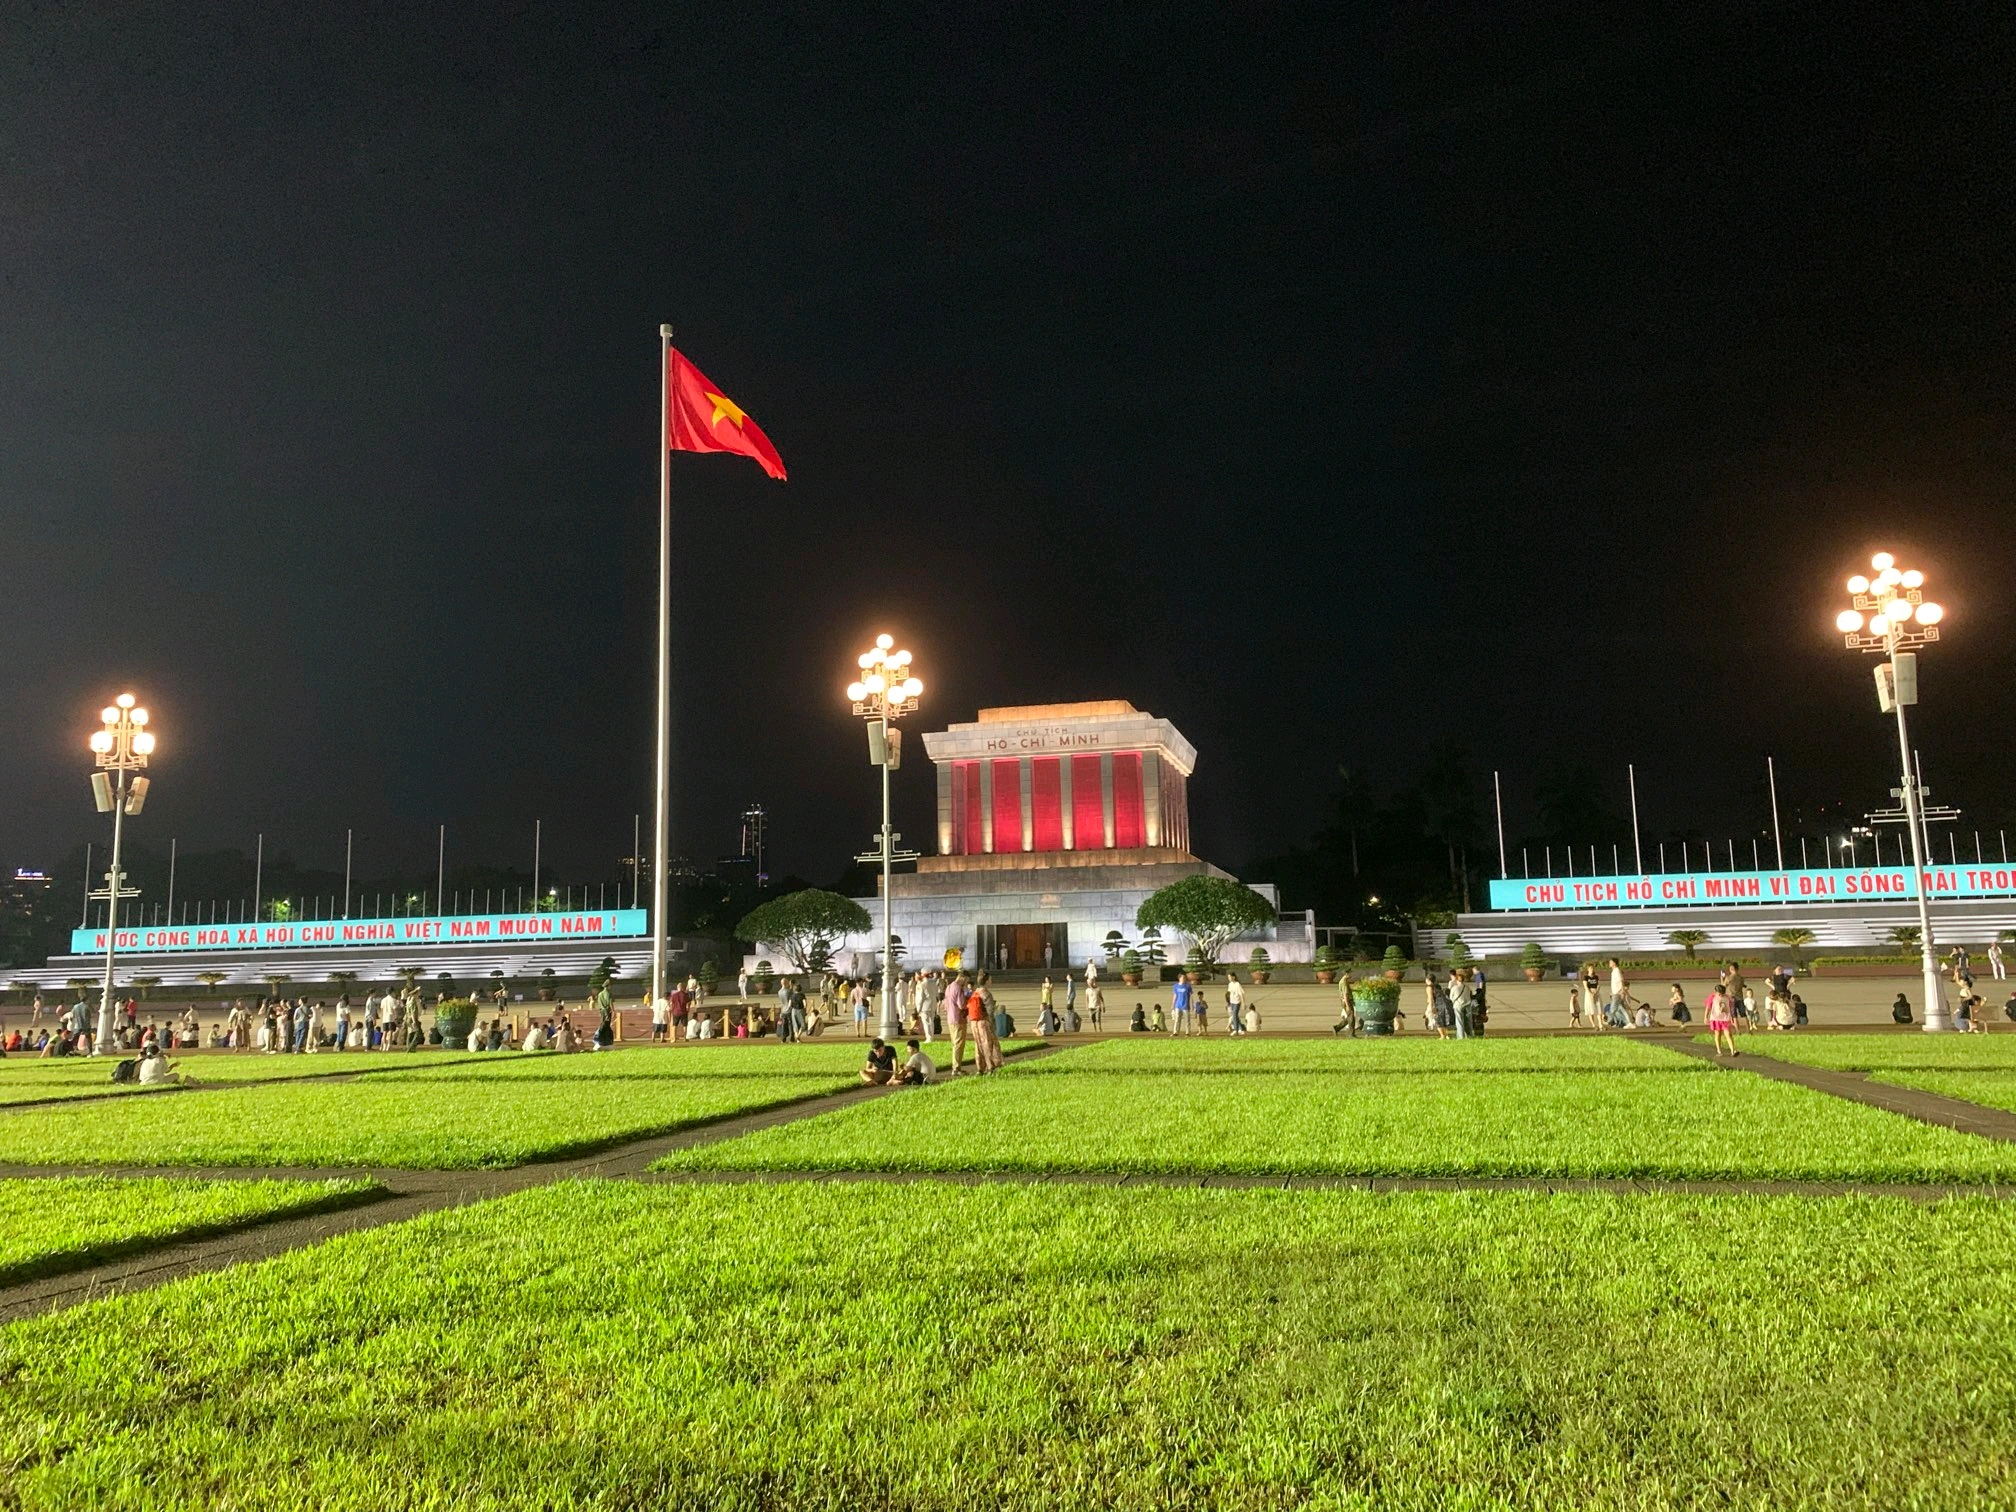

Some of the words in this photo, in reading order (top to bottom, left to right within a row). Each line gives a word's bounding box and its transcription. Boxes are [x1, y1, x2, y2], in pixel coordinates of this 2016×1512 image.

[1526, 880, 1565, 903] CHỦ
[1573, 882, 1618, 905] TỊCH
[1627, 876, 1653, 900] HỒ
[1662, 876, 1696, 899] CHÍ
[1705, 878, 1760, 898] MINH
[1769, 874, 1790, 896] VĨ
[1799, 875, 1835, 898] ĐẠI
[1845, 868, 1905, 894] SỐNG
[96, 931, 138, 948] NỚC
[146, 928, 190, 949] CỘNG
[266, 924, 294, 946] HỘI
[302, 921, 335, 942] CHỦ
[343, 922, 395, 940] NGHĨA
[405, 919, 442, 940] VIỆT
[451, 920, 490, 937] NAM
[499, 916, 552, 935] MUÔN
[561, 914, 602, 933] NĂM
